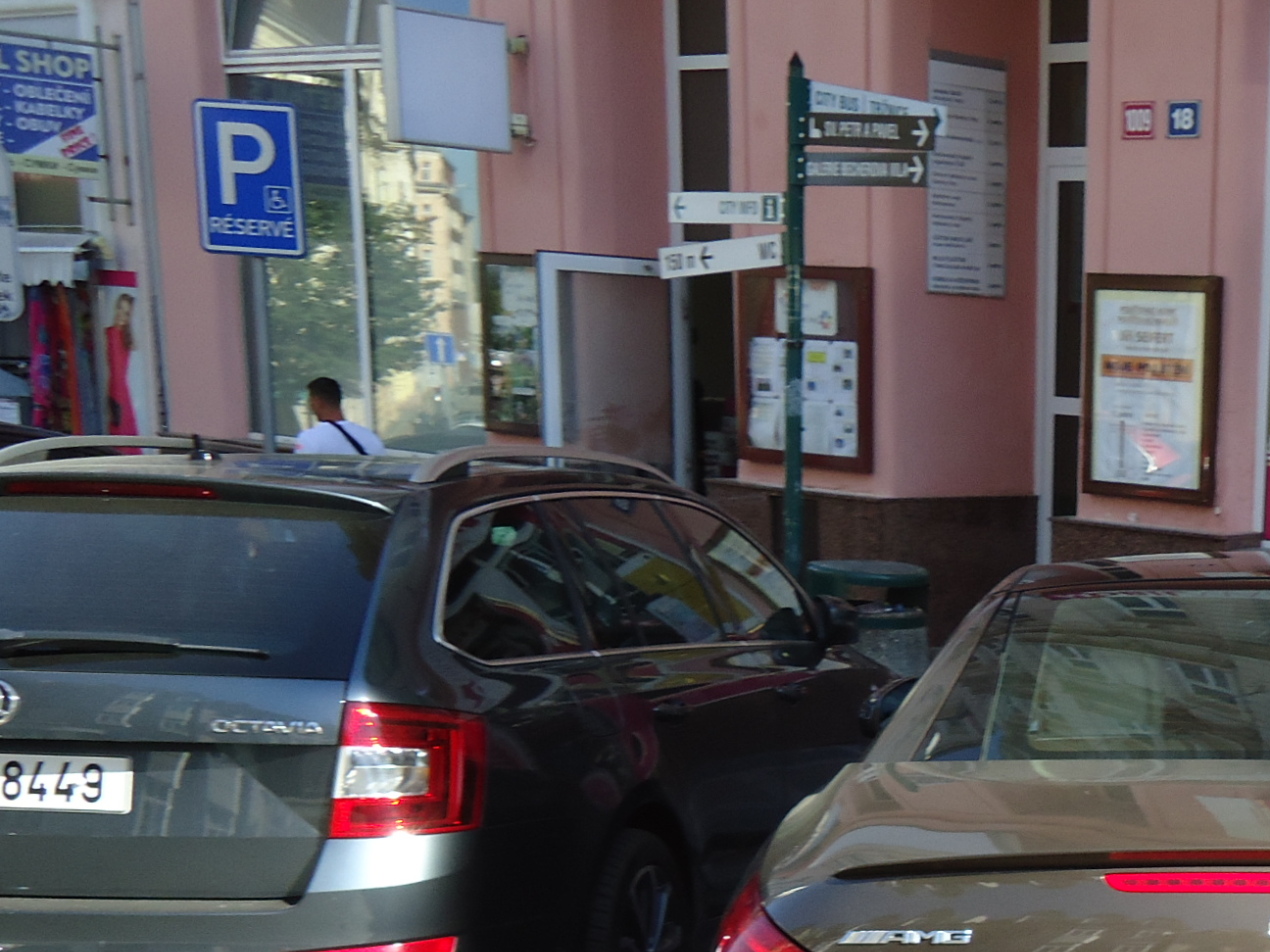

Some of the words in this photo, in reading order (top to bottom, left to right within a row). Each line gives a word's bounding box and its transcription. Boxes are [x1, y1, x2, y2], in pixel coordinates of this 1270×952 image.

[14, 49, 91, 79] SHOP
[14, 100, 86, 120] KABELKY
[1171, 107, 1194, 130] 18
[217, 121, 277, 206] P
[209, 213, 295, 239] RÉSERVÉ
[757, 241, 776, 260] WC
[210, 719, 324, 735] OCTAVIA
[2, 761, 102, 803] 8449
[884, 929, 973, 945] AMG
